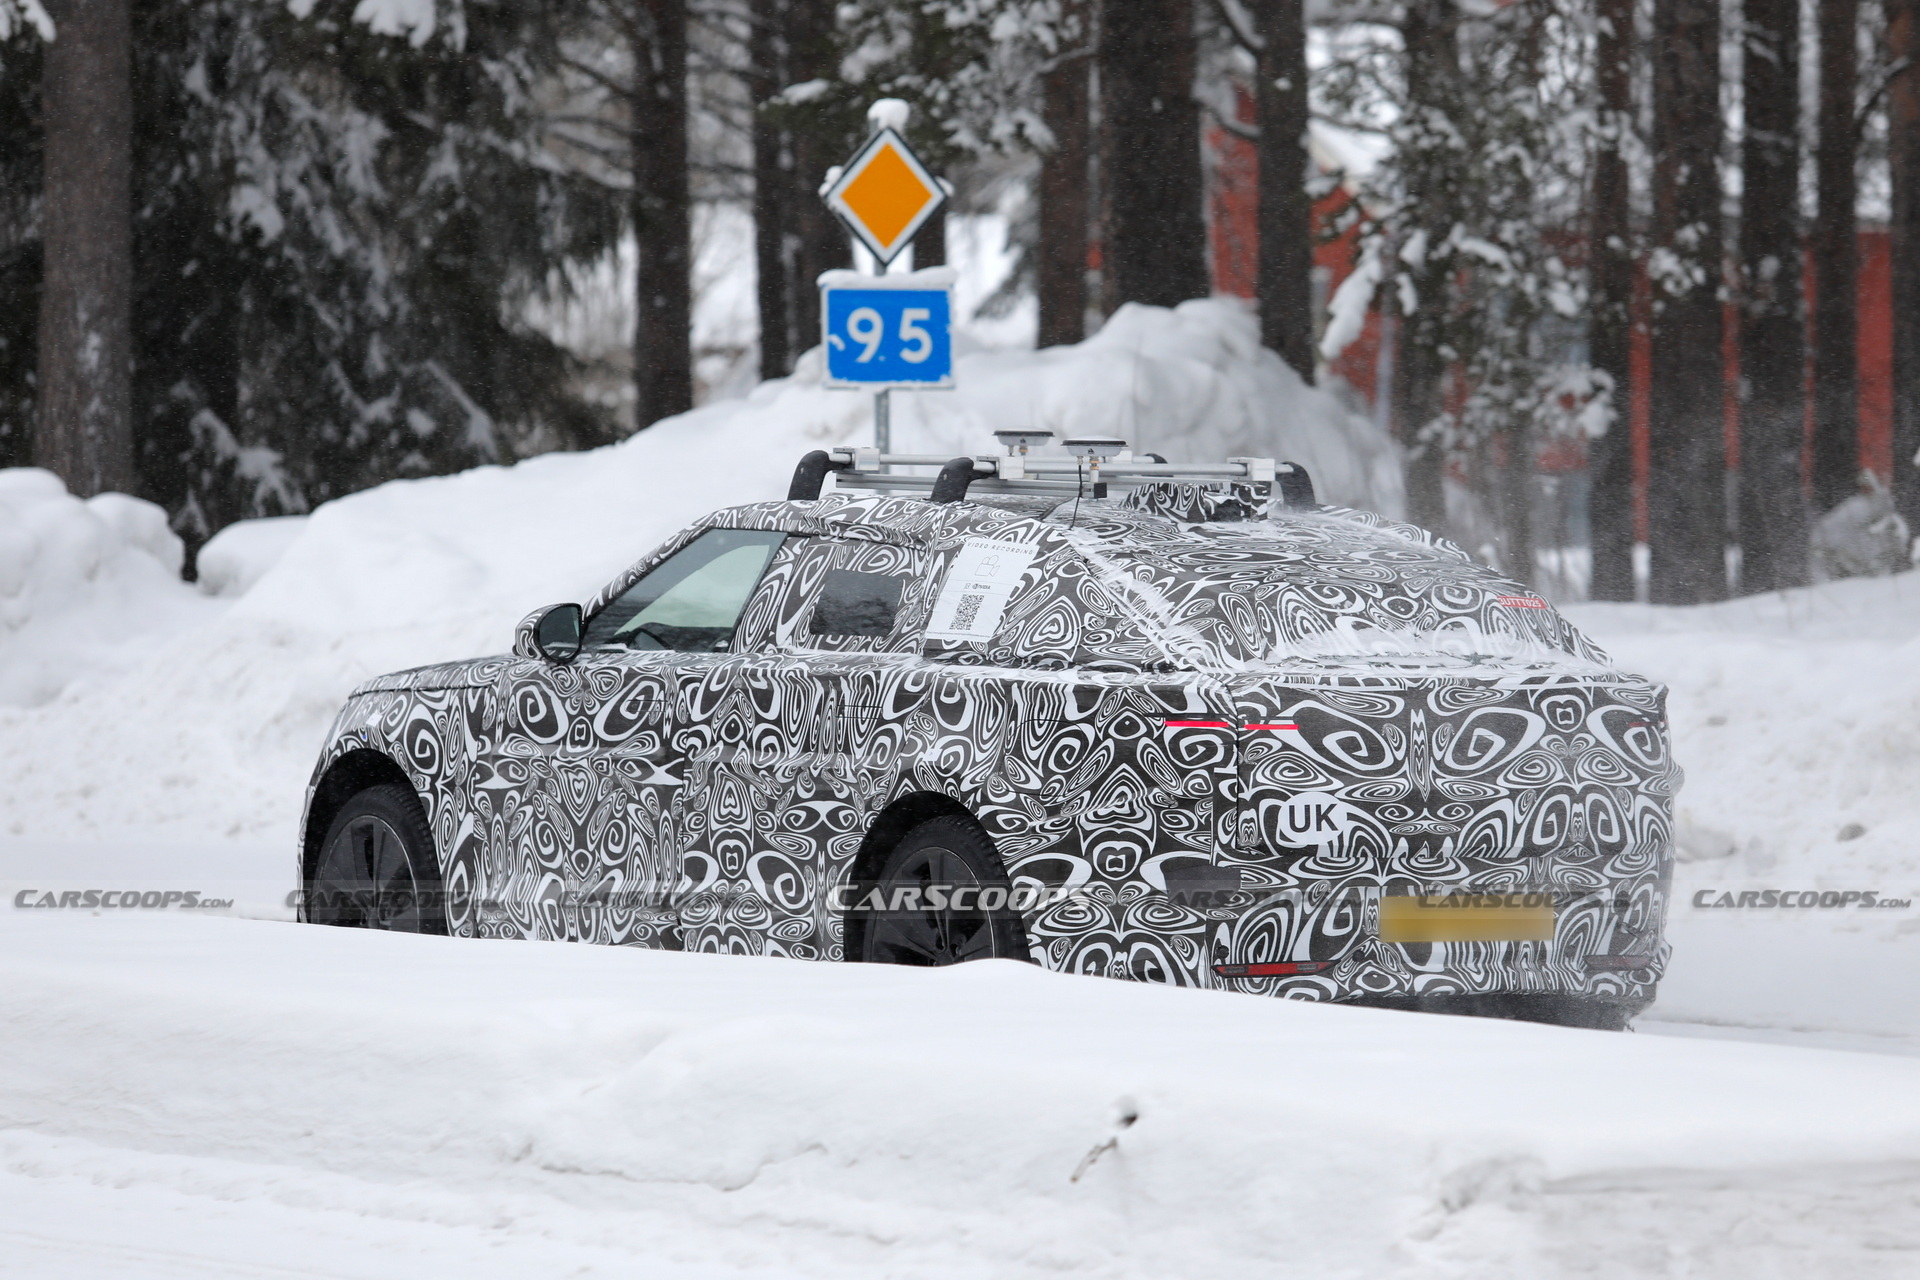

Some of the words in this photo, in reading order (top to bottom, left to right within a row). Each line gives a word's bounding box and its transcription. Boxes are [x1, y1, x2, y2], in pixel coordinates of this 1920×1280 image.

[846, 307, 933, 364] 95
[991, 545, 1034, 555] RECORDING
[1289, 803, 1339, 833] UK
